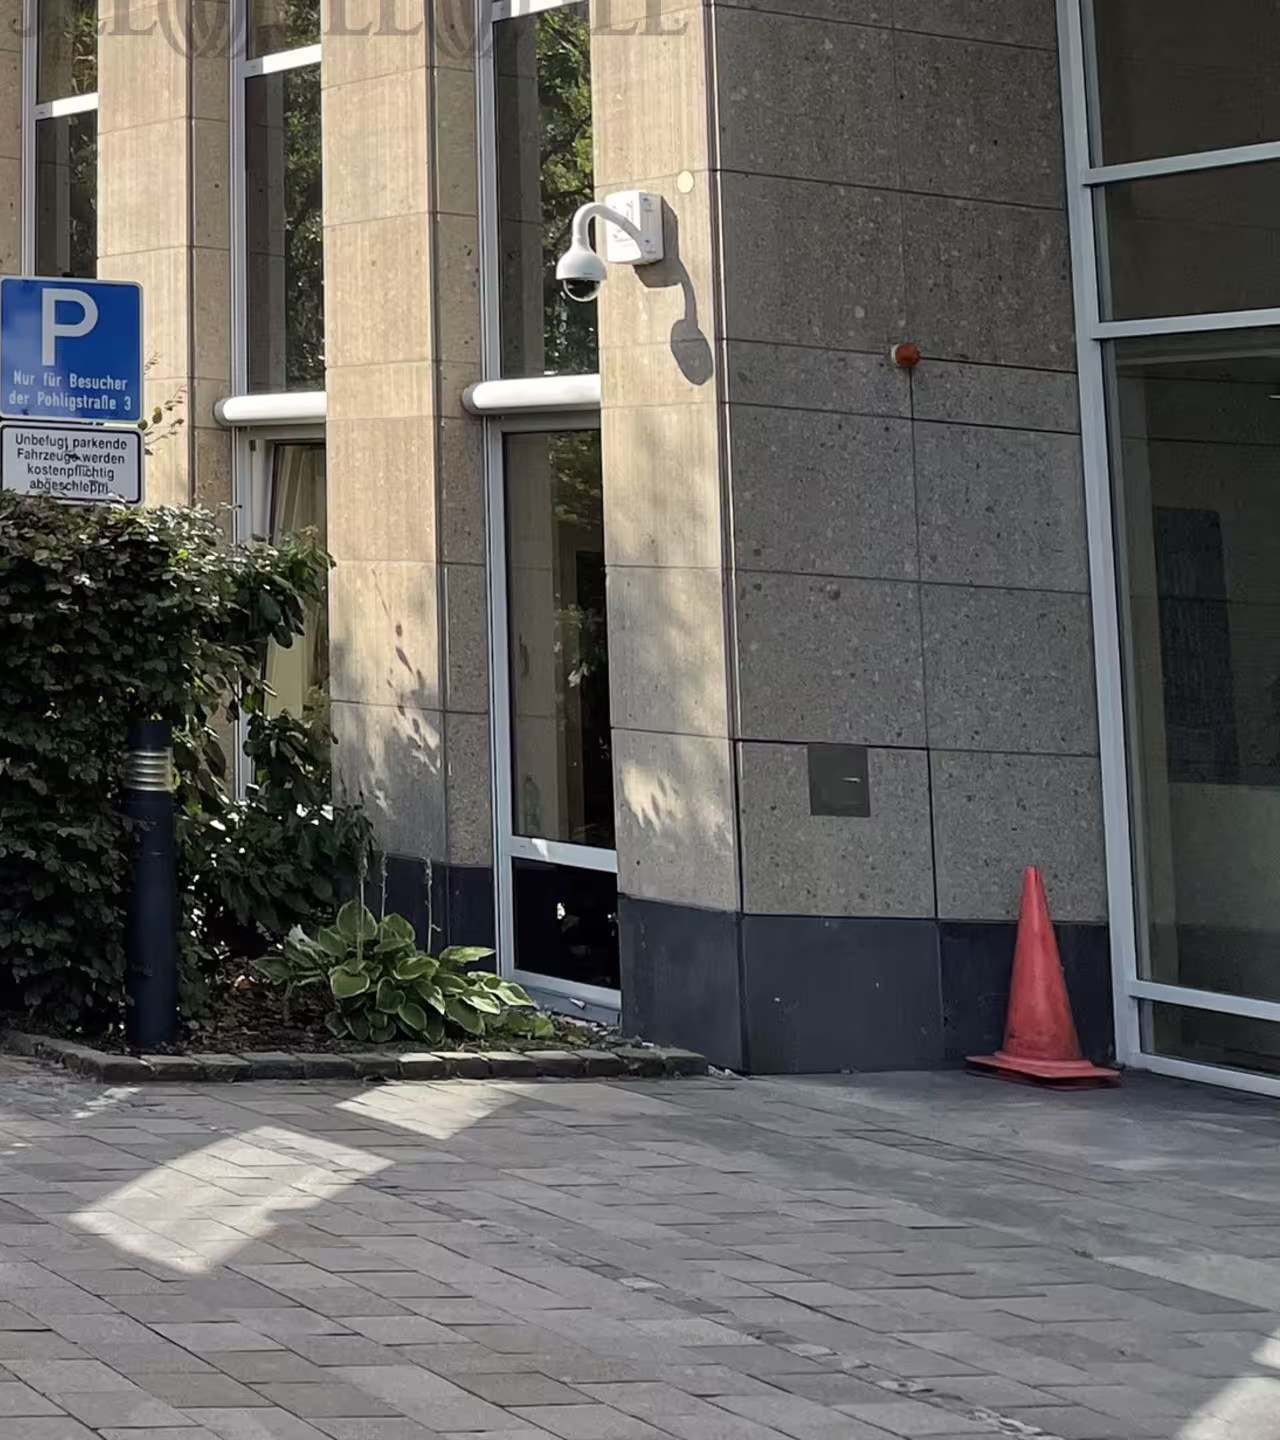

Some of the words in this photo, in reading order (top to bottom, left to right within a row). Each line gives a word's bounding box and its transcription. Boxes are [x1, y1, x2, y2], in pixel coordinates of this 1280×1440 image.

[41, 288, 98, 366] P
[13, 370, 36, 385] Nur
[43, 372, 62, 387] für
[69, 373, 128, 391] Besucher
[9, 390, 30, 405] der
[37, 391, 117, 411] Pohligstraße
[124, 395, 132, 411] 3
[15, 433, 69, 450] Unbefugt
[72, 437, 128, 451] parkende
[17, 448, 79, 464] Fahrzeuge
[82, 452, 126, 464] werden
[27, 463, 115, 481] kostenpflichtig
